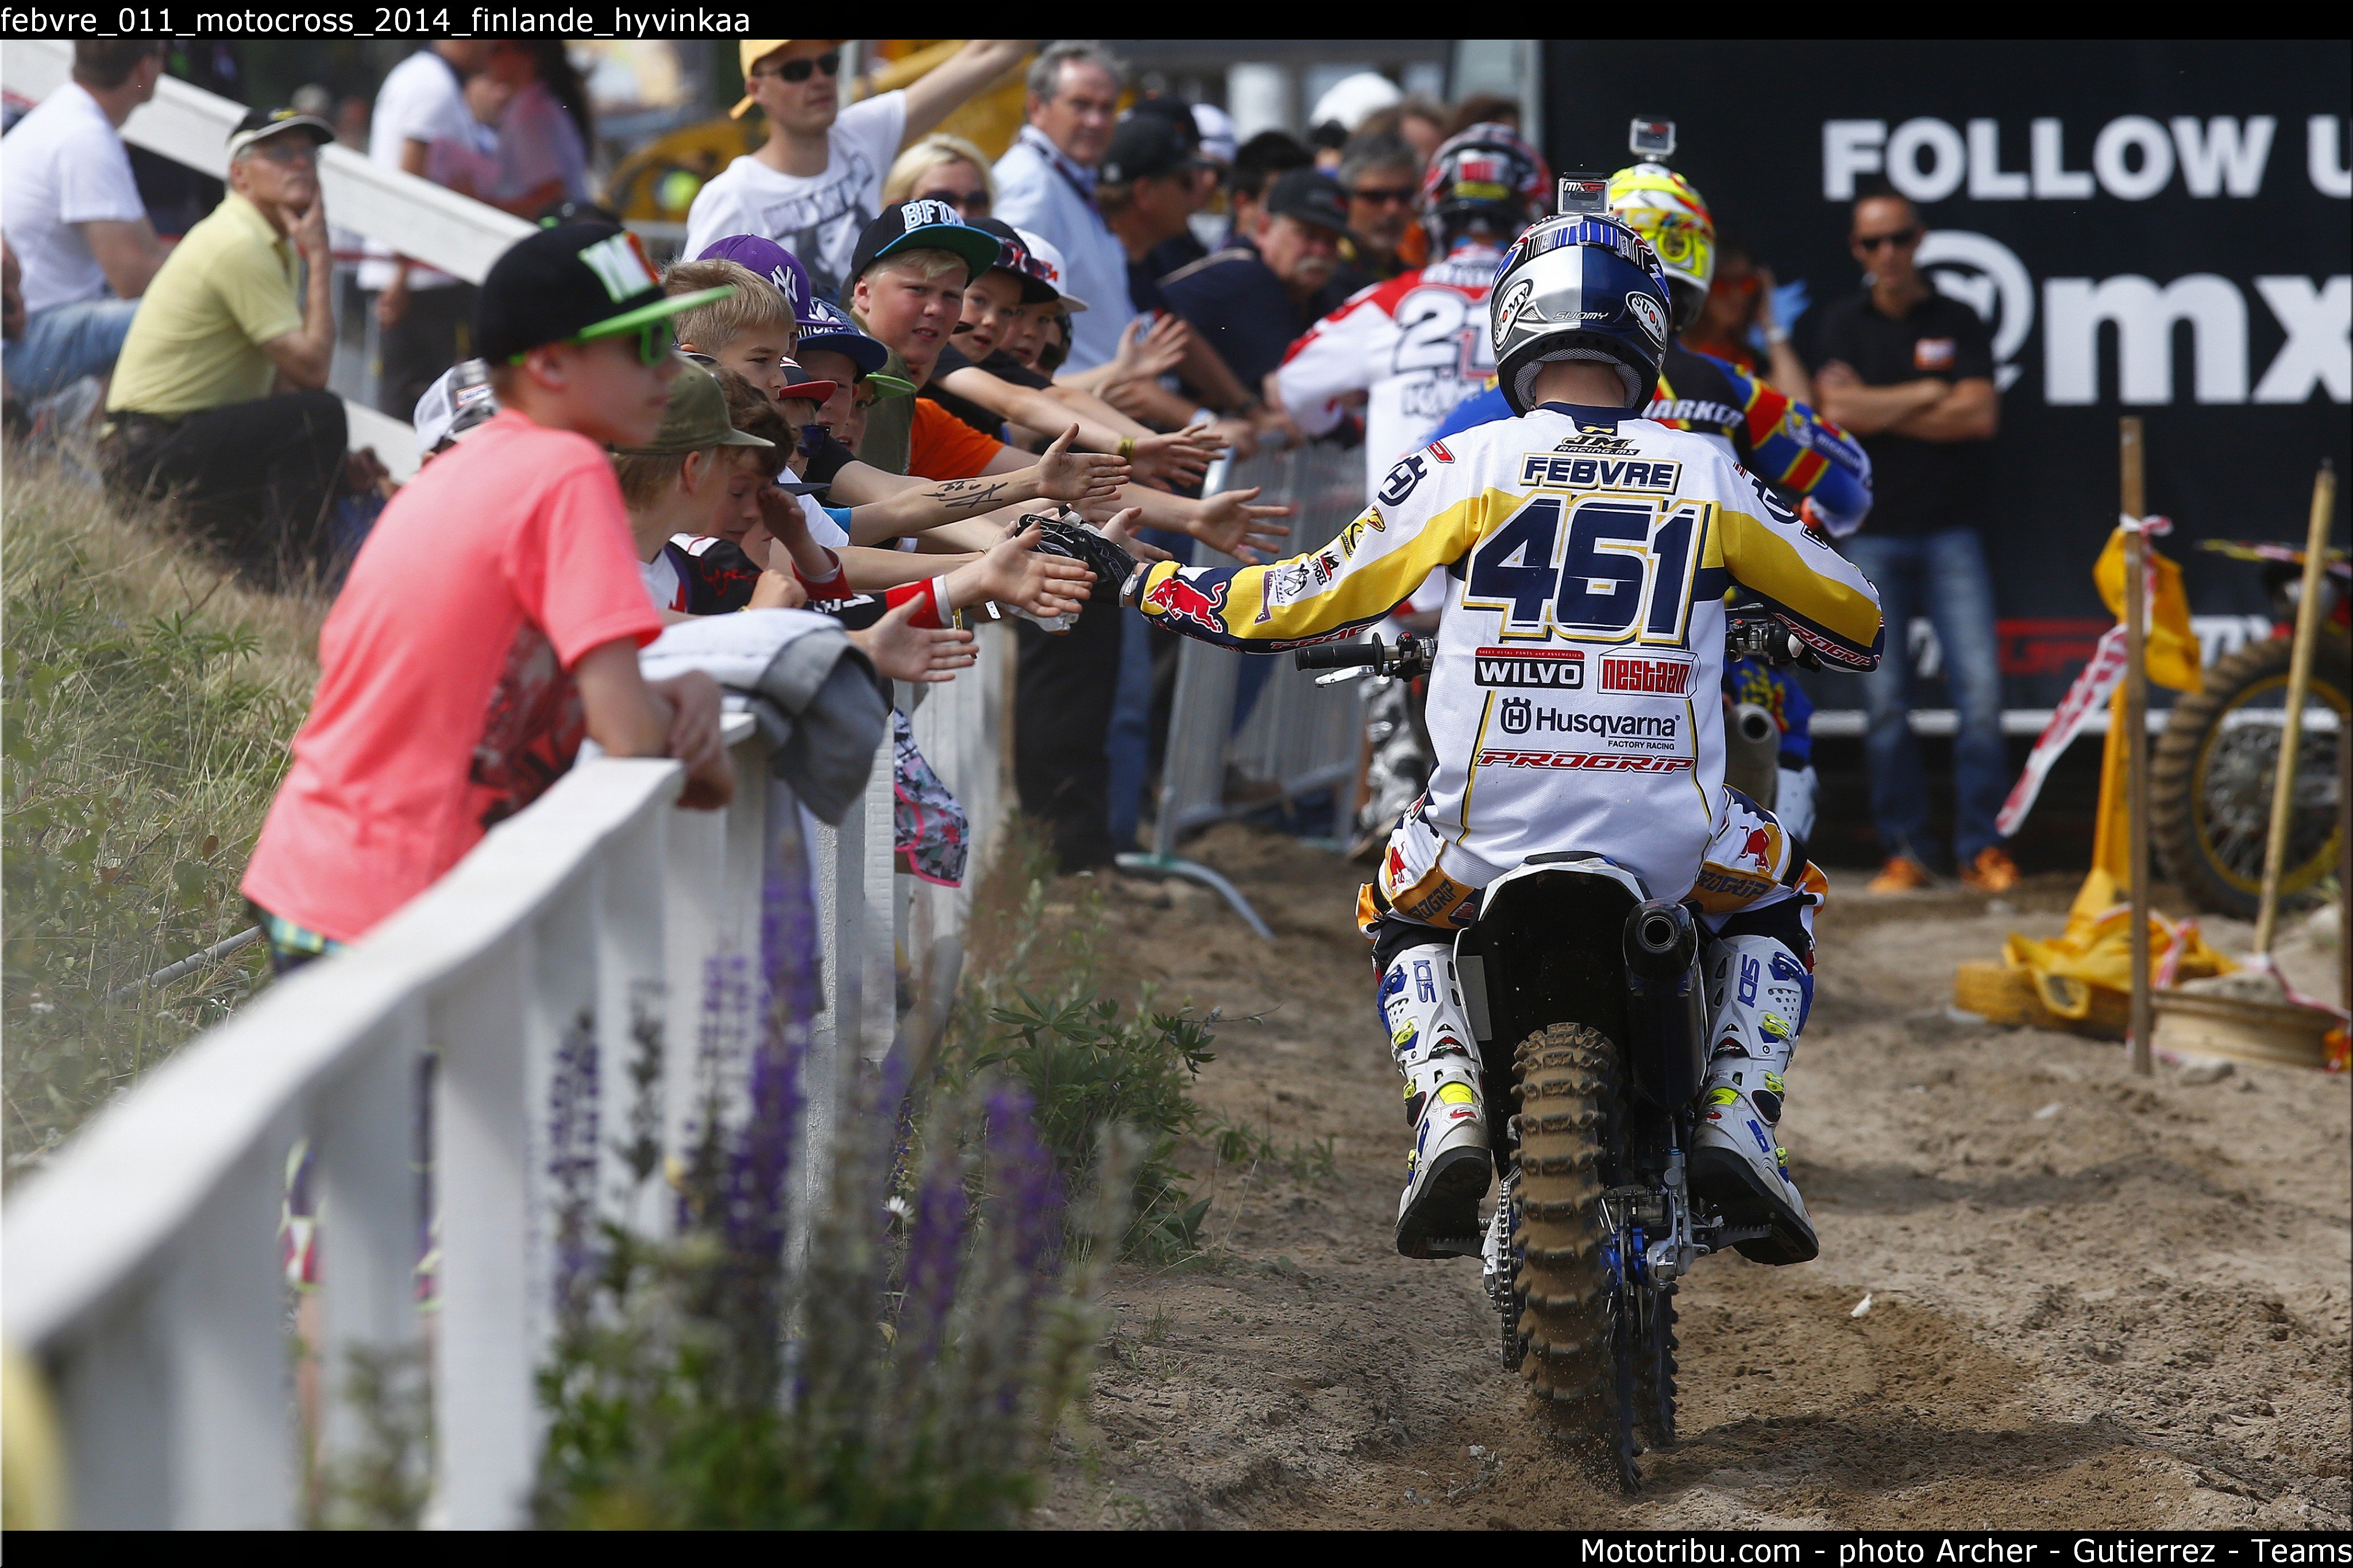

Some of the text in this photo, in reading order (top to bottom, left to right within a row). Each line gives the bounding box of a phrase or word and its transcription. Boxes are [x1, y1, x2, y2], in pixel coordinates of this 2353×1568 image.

[1823, 114, 2277, 202] FOLLOW
[1553, 311, 1609, 320] SUOMY
[1562, 435, 1637, 449] JM
[1524, 455, 1676, 488] FEBVRE
[1464, 494, 1705, 642] 461
[1479, 661, 1580, 685] WILVO
[1602, 659, 1691, 694] nestaan
[1536, 707, 1676, 738] Husqvarna
[1608, 740, 1675, 751] FACTORY RACING
